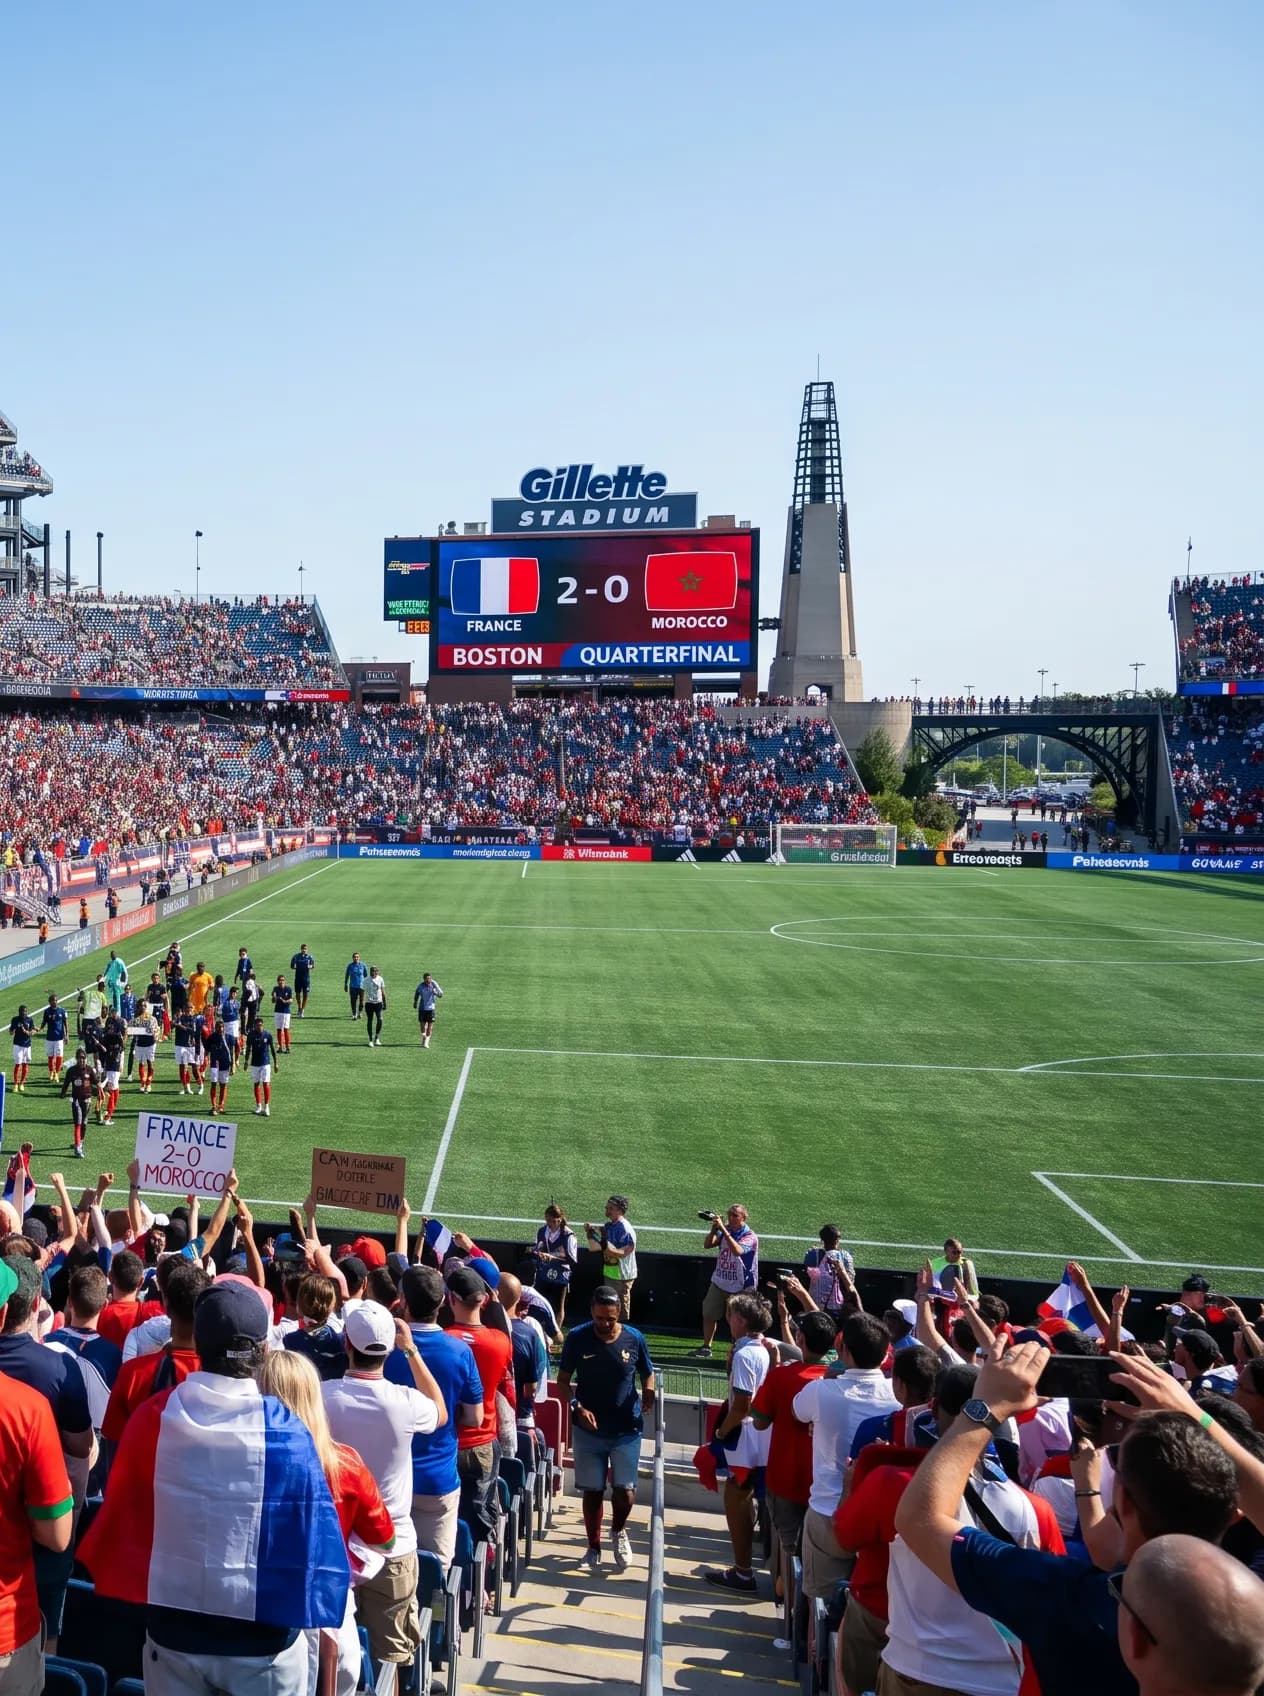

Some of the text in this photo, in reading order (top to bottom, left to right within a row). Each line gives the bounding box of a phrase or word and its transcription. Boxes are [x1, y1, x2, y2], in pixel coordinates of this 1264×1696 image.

[520, 464, 667, 502] Gillette
[518, 506, 669, 527] STADIUM
[466, 619, 522, 632] FRANCE
[651, 615, 728, 630] MOROCCO
[453, 645, 741, 666] BOSTON QUARTERFINAL
[146, 1116, 230, 1149] FRANCE
[161, 1144, 201, 1167] 2-0
[144, 1163, 227, 1193] MOROCCO
